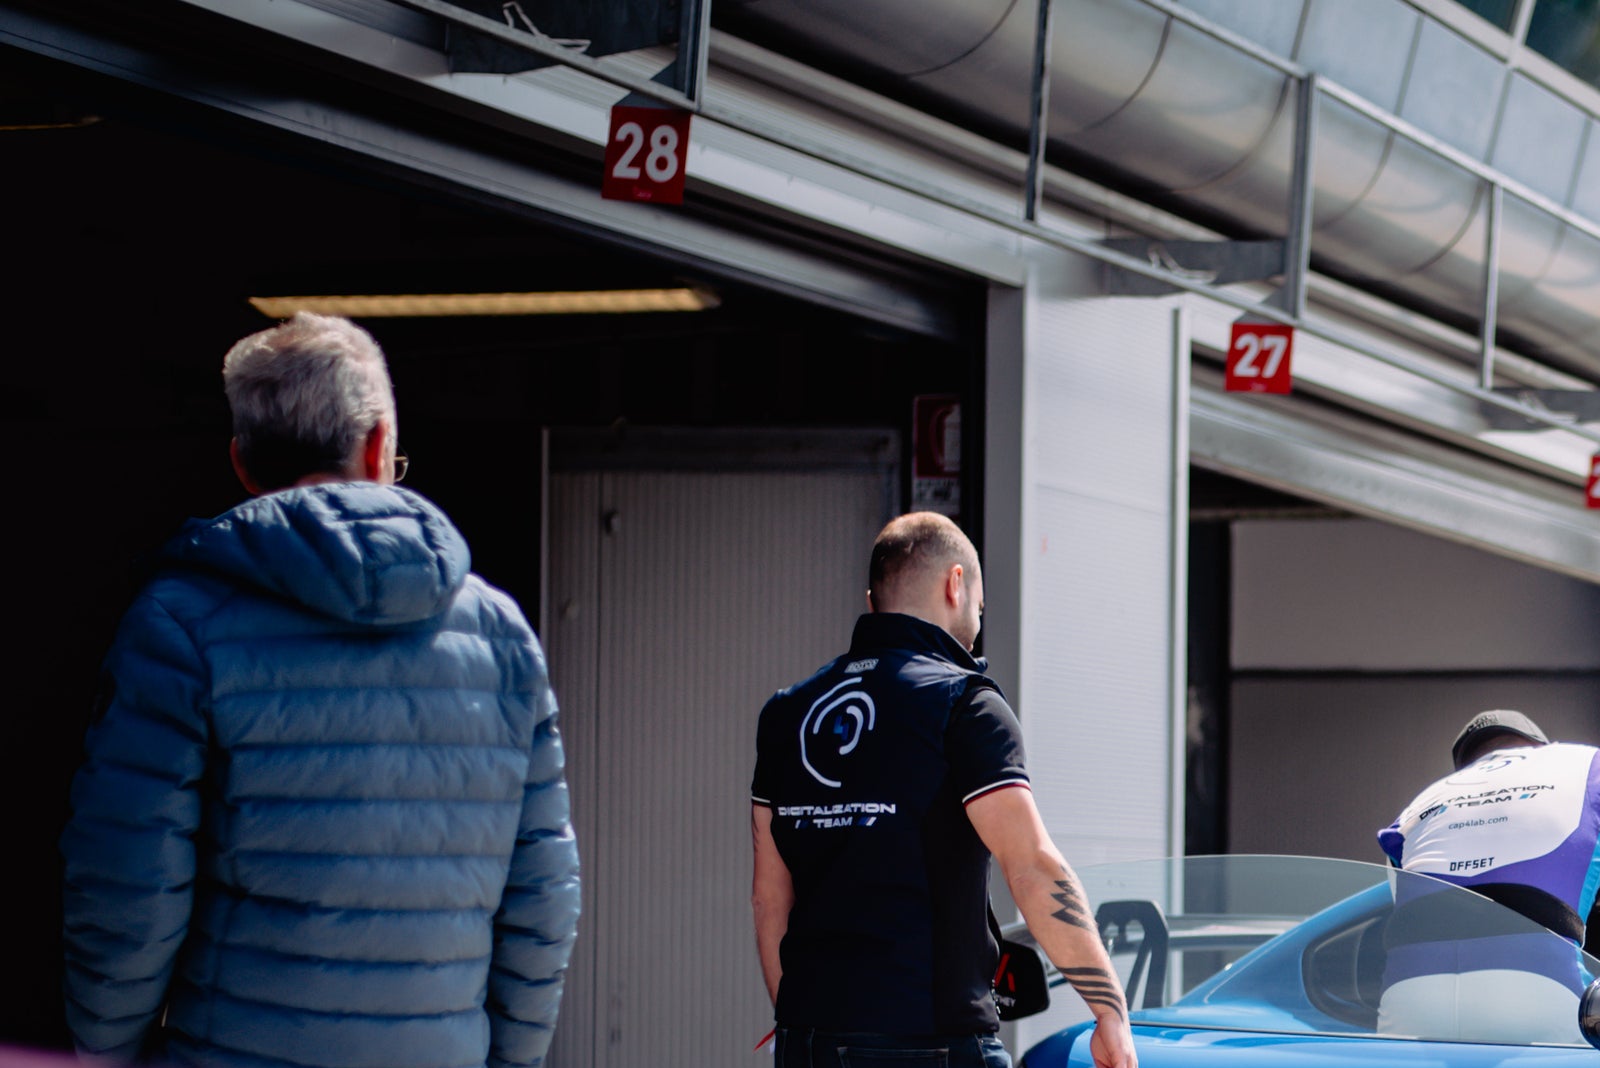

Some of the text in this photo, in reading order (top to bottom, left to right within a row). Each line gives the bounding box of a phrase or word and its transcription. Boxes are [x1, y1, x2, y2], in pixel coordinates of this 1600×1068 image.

[612, 122, 678, 183] 28
[1233, 332, 1289, 379] 27
[1455, 795, 1512, 808] TEAM
[778, 803, 896, 816] DIGITALIZATION
[813, 816, 853, 828] TEAM
[1448, 815, 1508, 831] cap4lab.com
[1449, 857, 1495, 871] OFFSET
